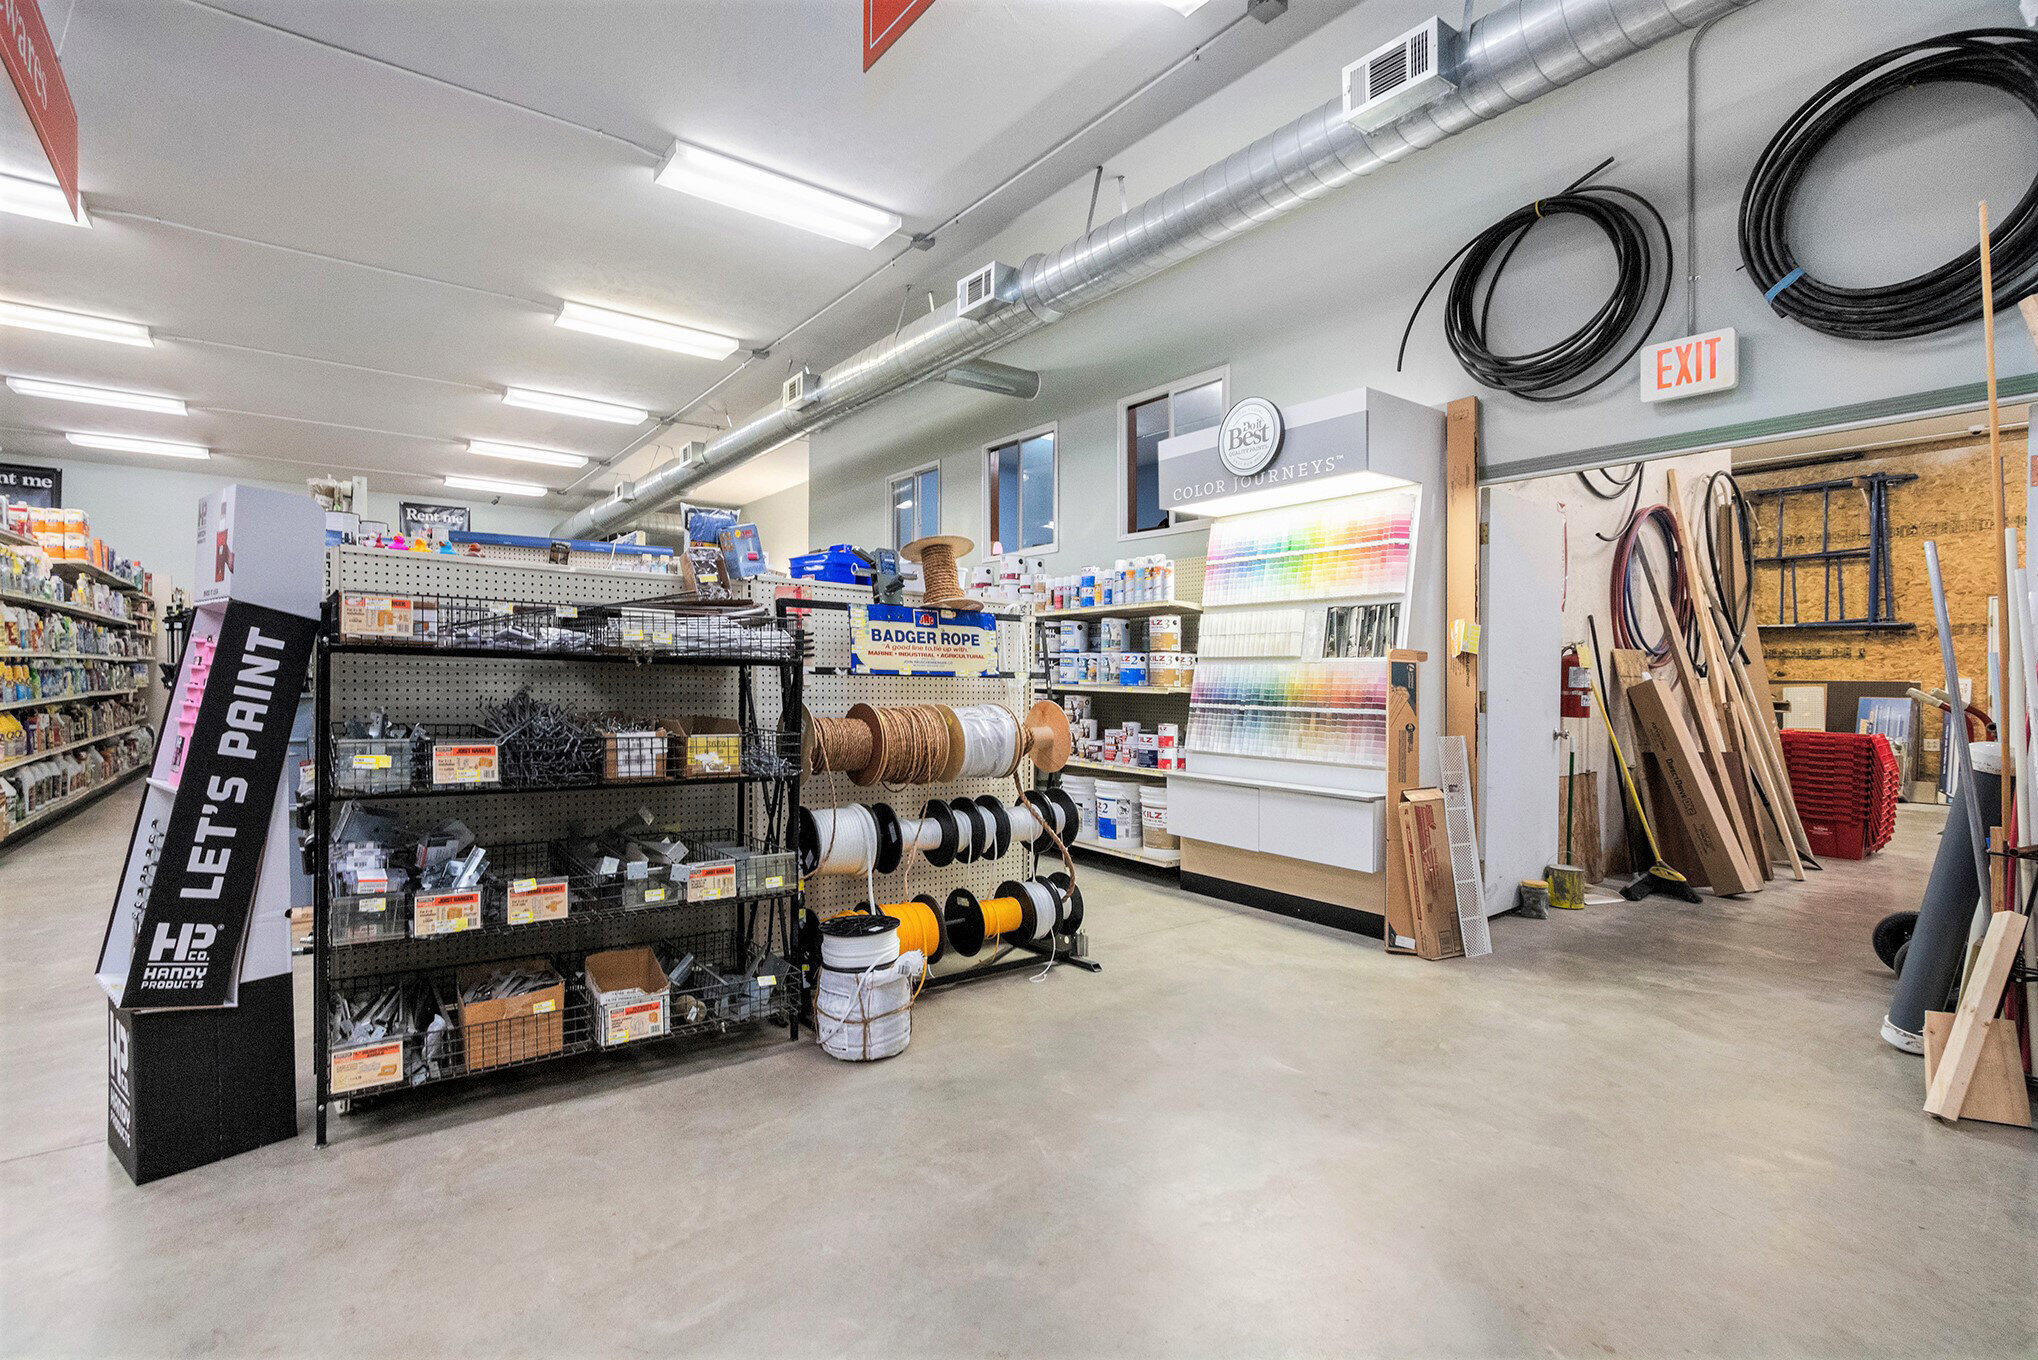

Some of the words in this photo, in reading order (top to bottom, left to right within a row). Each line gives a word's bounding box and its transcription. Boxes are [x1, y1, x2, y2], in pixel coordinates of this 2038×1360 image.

[1657, 336, 1721, 390] EXIT
[1228, 424, 1269, 450] Best
[22, 476, 53, 489] me
[1173, 480, 1226, 500] COLOR
[406, 507, 440, 522] Rent
[871, 628, 937, 645] BADGER
[941, 633, 981, 647] ROPE
[1131, 655, 1138, 665] 2
[217, 626, 286, 760] PAINT
[1102, 802, 1109, 814] 2
[188, 951, 210, 961] CO.
[143, 967, 208, 980] HANDY
[140, 980, 205, 990] PRODUCTS
